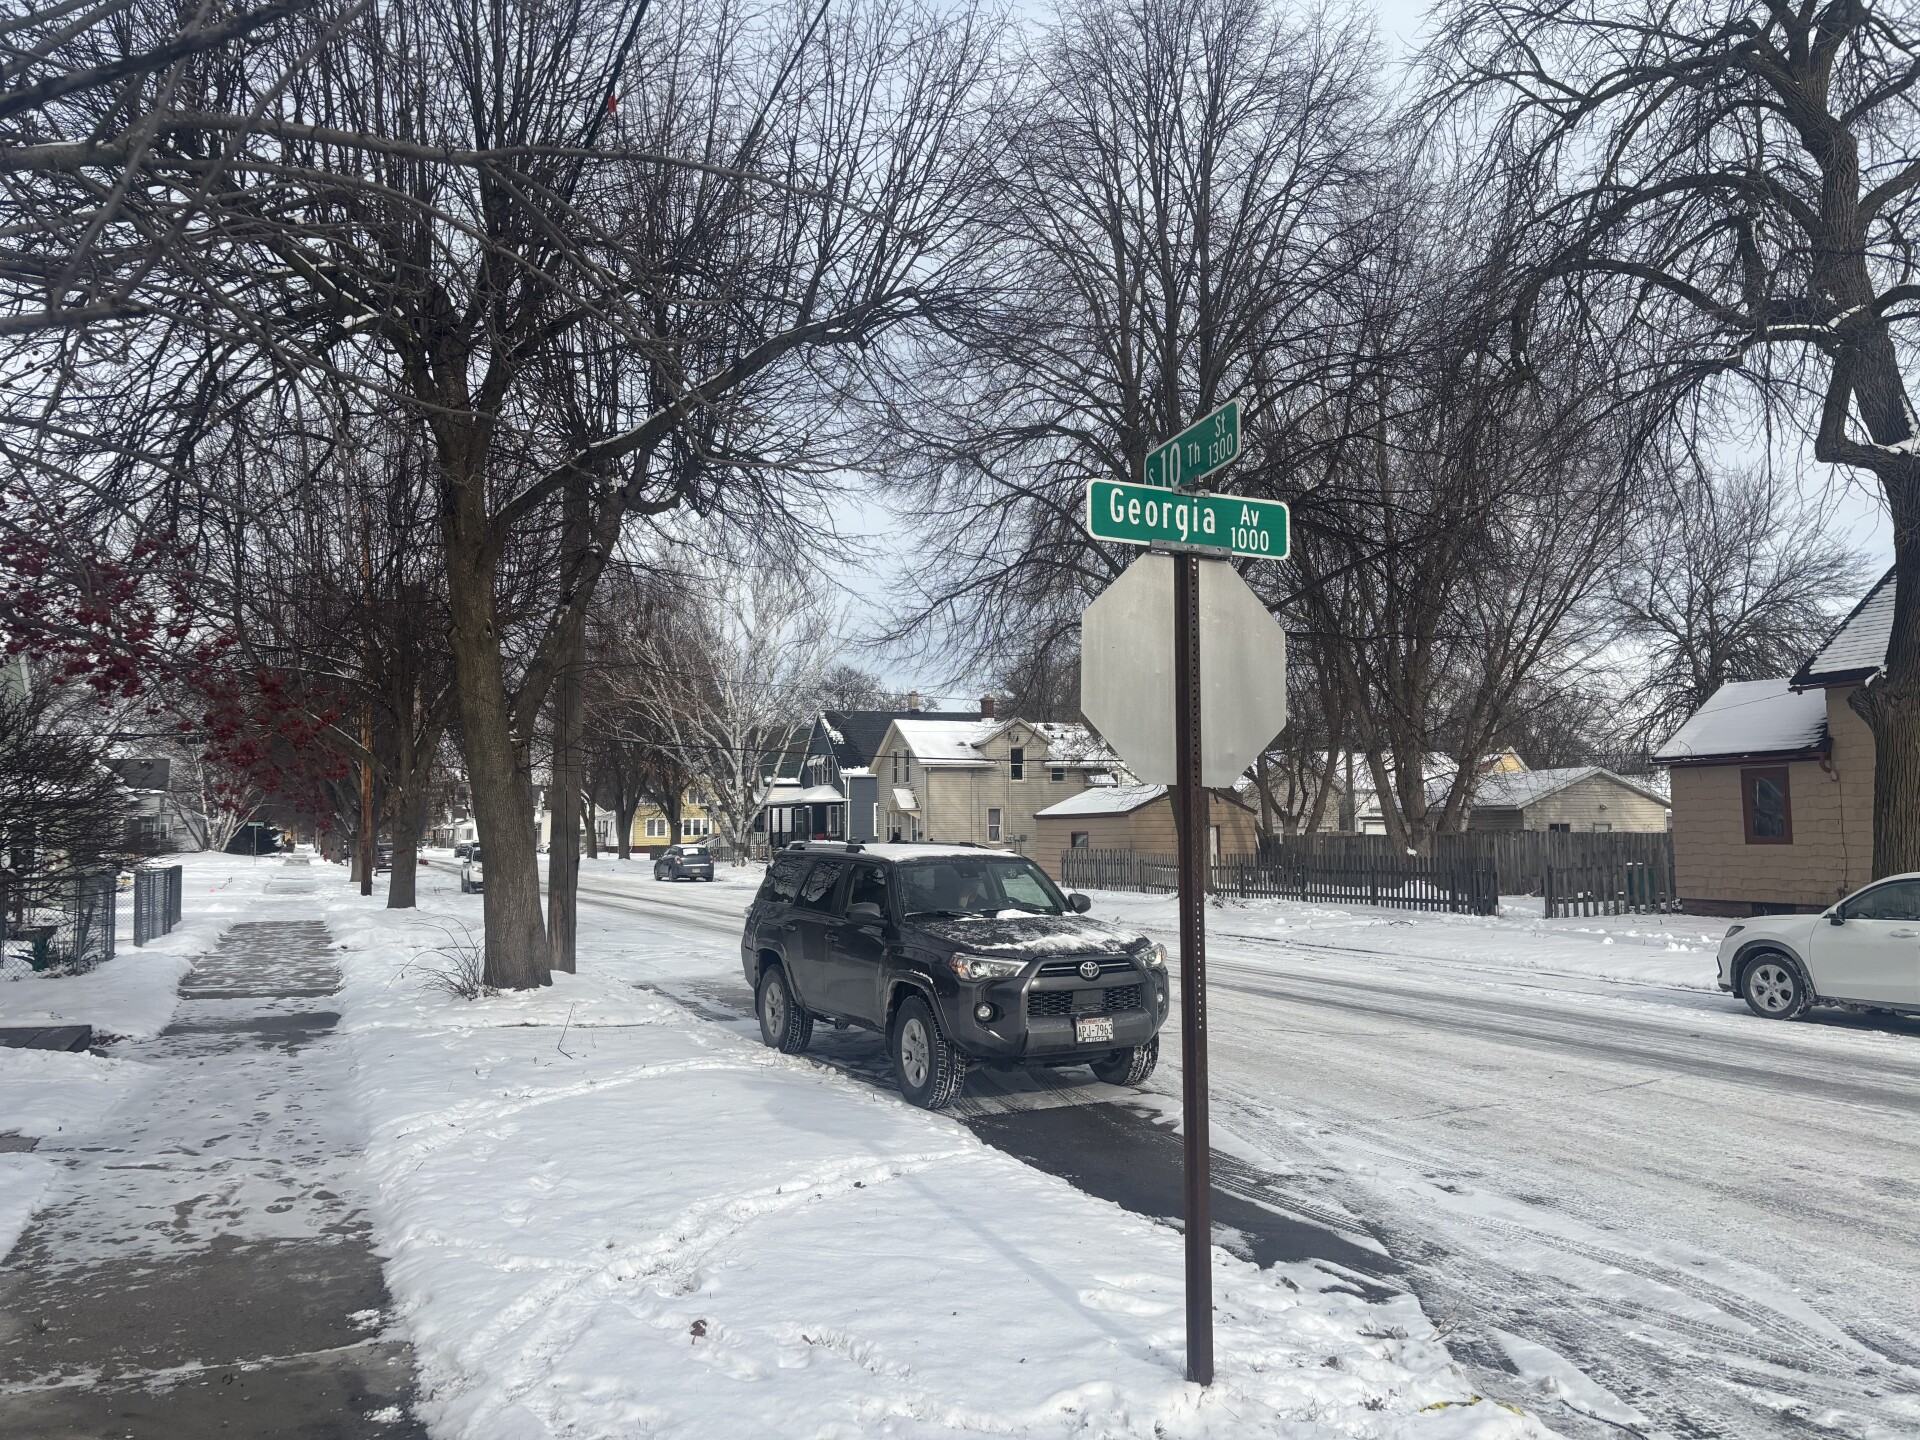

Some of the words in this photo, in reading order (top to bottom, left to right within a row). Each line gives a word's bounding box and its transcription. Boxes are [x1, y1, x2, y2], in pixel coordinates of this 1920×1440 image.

[1160, 442, 1181, 488] 10
[1187, 441, 1201, 468] Th
[1215, 412, 1226, 438] St
[1208, 433, 1233, 467] 1300
[1110, 487, 1216, 542] Georgia
[1240, 504, 1260, 527] Av
[1230, 527, 1270, 552] 1000
